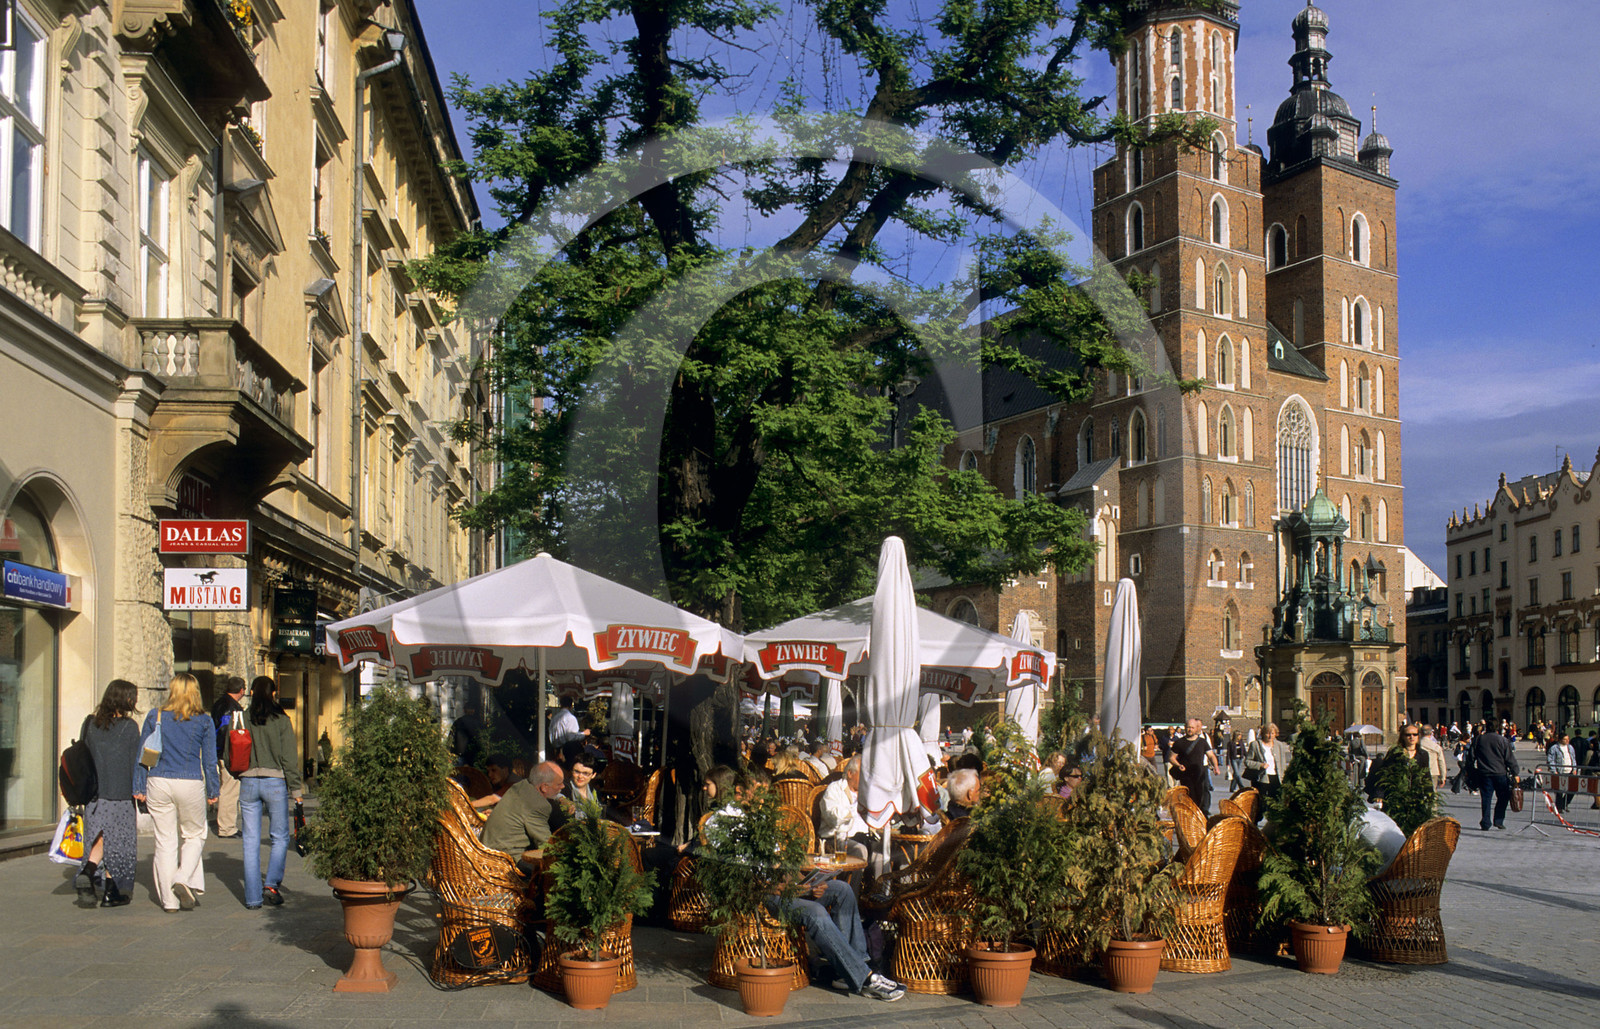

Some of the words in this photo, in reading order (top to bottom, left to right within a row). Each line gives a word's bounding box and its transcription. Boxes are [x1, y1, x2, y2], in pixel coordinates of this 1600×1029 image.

[166, 527, 242, 542] DALLAS
[170, 586, 241, 605] MUSTANG
[616, 626, 680, 653] ŻYWIEC
[775, 642, 829, 662] ŻYWIEC
